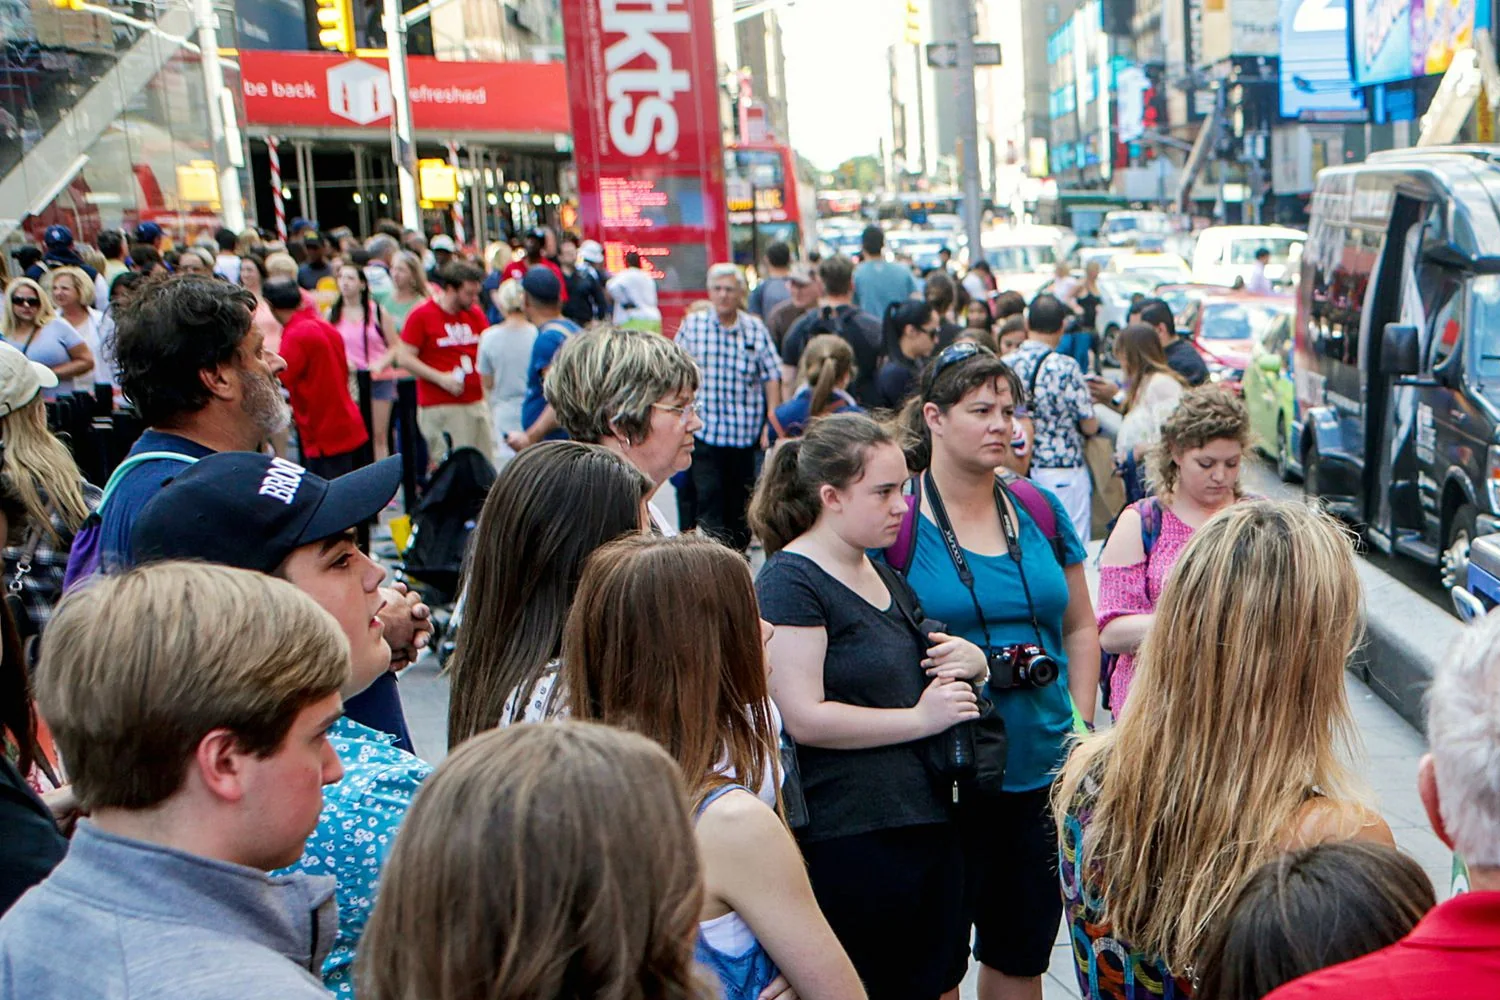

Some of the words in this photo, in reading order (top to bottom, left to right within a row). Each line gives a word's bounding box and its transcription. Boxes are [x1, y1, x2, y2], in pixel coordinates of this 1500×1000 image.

[243, 79, 268, 97] be
[271, 80, 317, 99] back
[408, 84, 487, 105] efreshed
